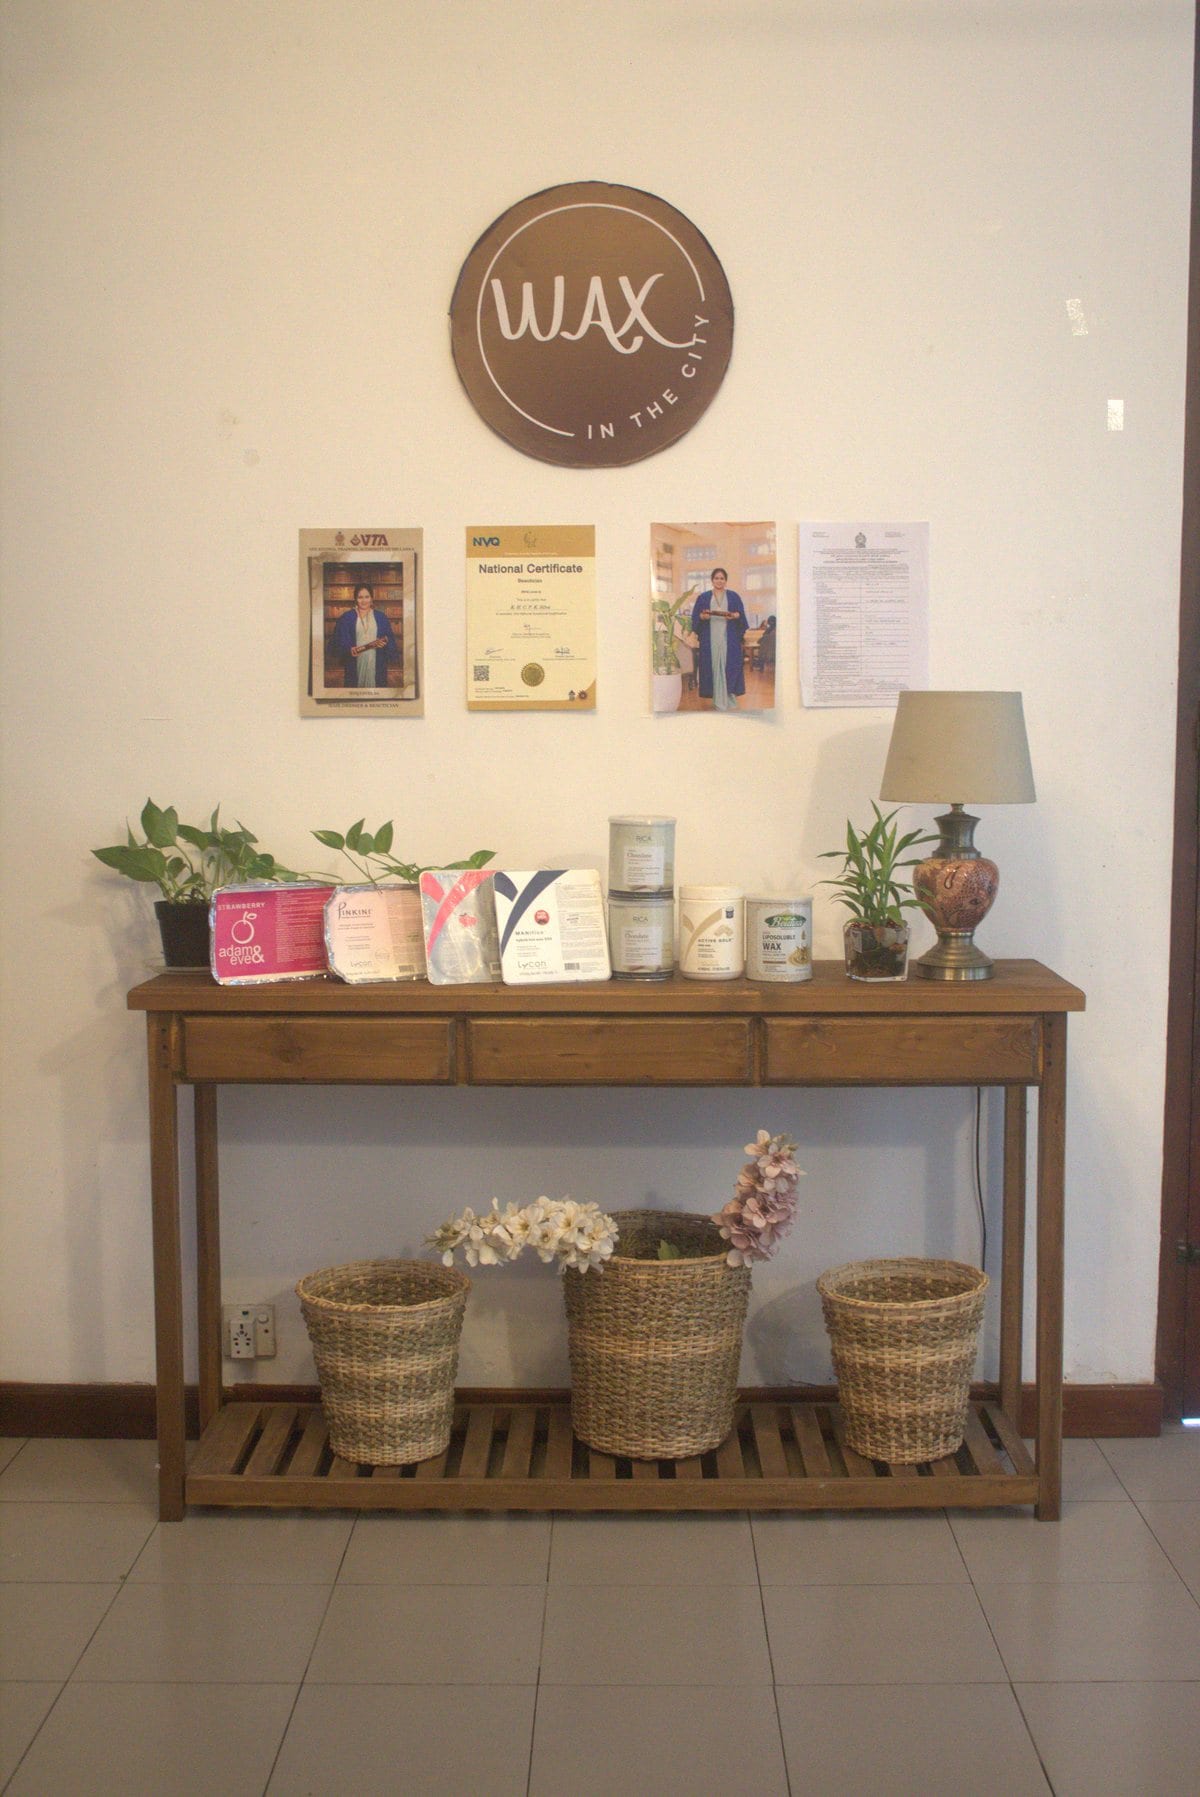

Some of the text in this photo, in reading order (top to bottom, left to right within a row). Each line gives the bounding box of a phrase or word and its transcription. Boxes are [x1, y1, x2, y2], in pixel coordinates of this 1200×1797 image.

[491, 273, 695, 354] WAX
[588, 314, 709, 439] IN THE CITY
[360, 534, 388, 546] VTA
[473, 537, 500, 547] NVQ
[479, 563, 583, 574] National Certificate
[217, 902, 266, 911] STRAWBERRY
[218, 945, 254, 957] adam
[230, 955, 252, 965] eve
